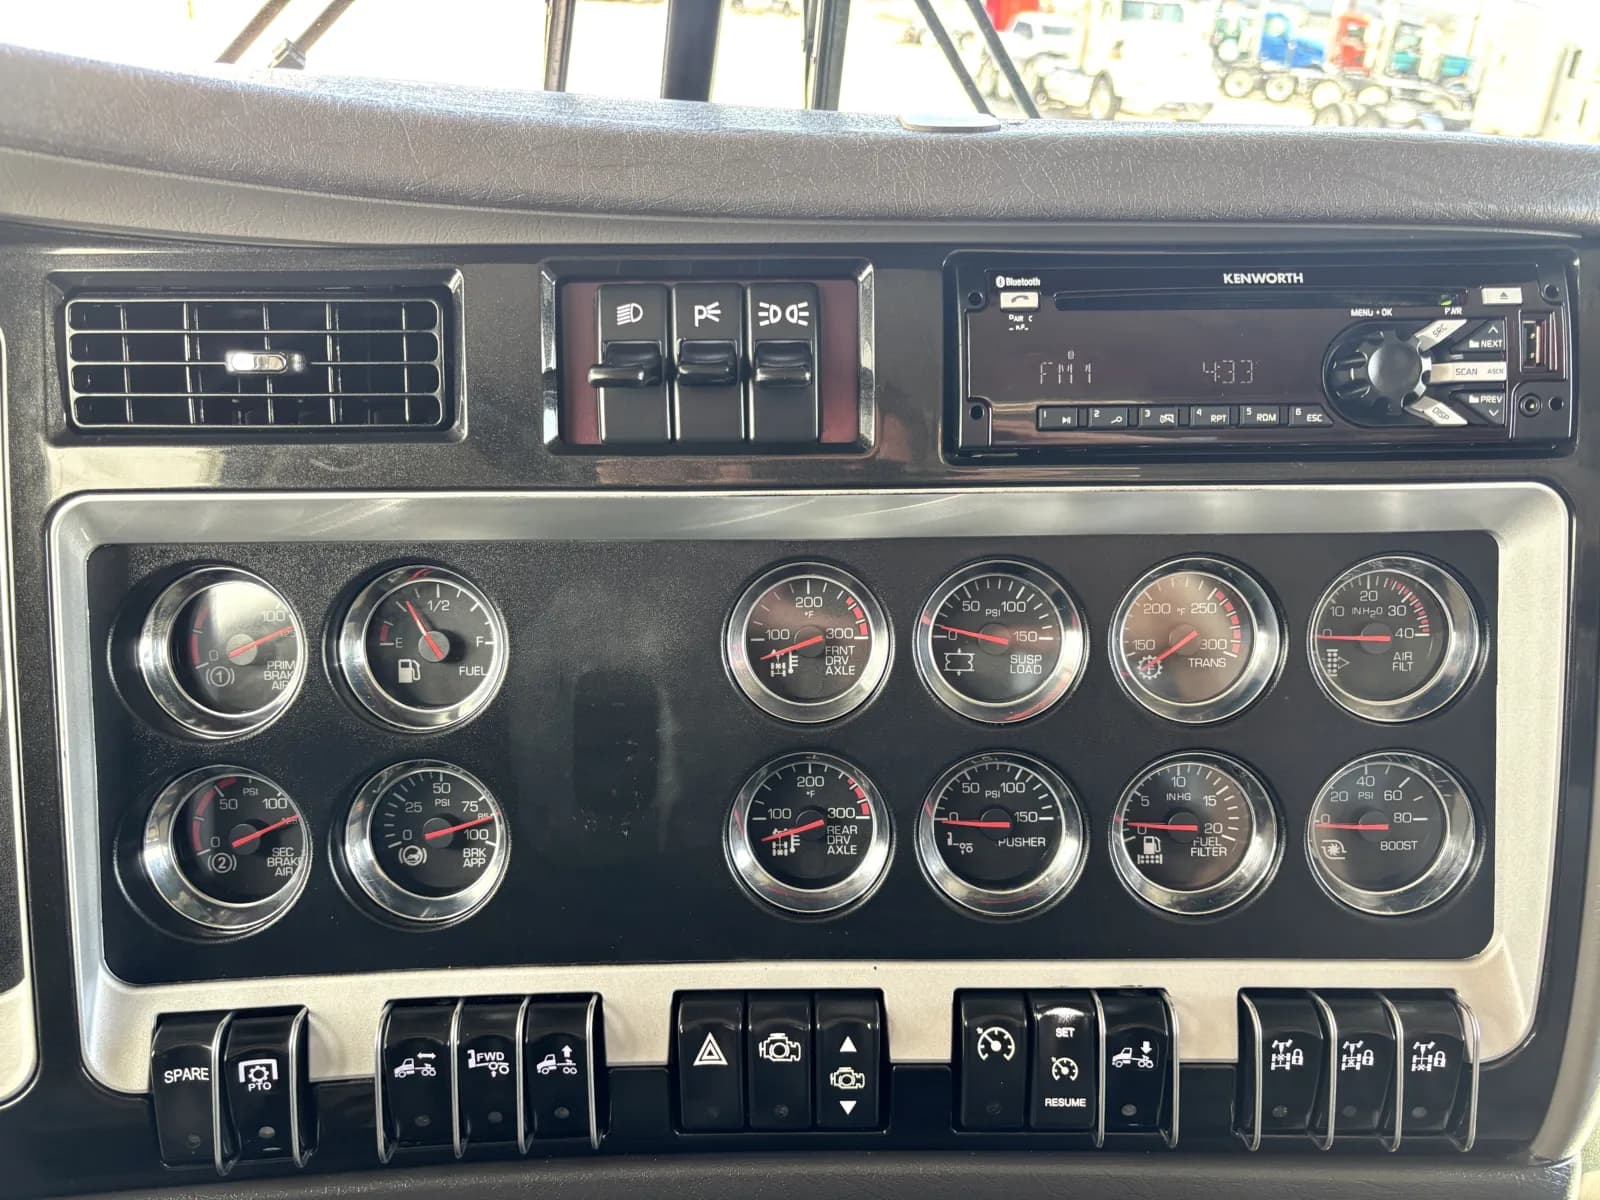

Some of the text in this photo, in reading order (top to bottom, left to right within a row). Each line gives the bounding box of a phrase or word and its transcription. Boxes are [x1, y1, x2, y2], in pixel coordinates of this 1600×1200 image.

[1005, 276, 1040, 287] Bluetooth
[1223, 272, 1304, 284] KENWORTH
[1350, 308, 1393, 317] MENU OK
[1432, 323, 1449, 338] SRC
[1481, 340, 1503, 348] NEXT
[1455, 368, 1478, 376] SCAN
[1480, 395, 1503, 404] PREV
[1093, 409, 1100, 418] 2
[1144, 409, 1151, 418] 3
[1196, 408, 1227, 423] 4 RPT
[1246, 407, 1252, 416] 5
[1295, 408, 1323, 422] 6 ESC
[1432, 406, 1450, 420] DISP
[1359, 590, 1378, 601] 20
[427, 600, 450, 612] 1/2
[795, 597, 823, 608] 200
[962, 601, 980, 612] 50
[1000, 601, 1026, 613] 100
[985, 609, 1000, 617] PSI
[1143, 603, 1170, 614] 200
[1190, 603, 1217, 614] 250
[1330, 606, 1345, 617] 10
[1388, 605, 1406, 616] 30
[263, 610, 286, 622] 100
[766, 629, 790, 640] 100
[825, 628, 853, 640] 300
[1014, 631, 1037, 642] 150
[1395, 628, 1414, 639] 40
[395, 638, 403, 648] E
[476, 636, 484, 647] F
[1133, 640, 1155, 650] 150
[1200, 639, 1227, 650] 300
[825, 646, 855, 655] FRNT
[1393, 652, 1413, 660] AIR
[267, 660, 296, 670] PRIM
[825, 656, 849, 665] DRV
[1010, 655, 1042, 664] SUSP
[1188, 658, 1226, 668] TRANS
[459, 666, 486, 676] FUEL
[825, 666, 855, 675] AXLE
[1010, 665, 1042, 675] LOAD
[1393, 662, 1414, 672] FILT
[264, 670, 295, 680] BRAK
[797, 776, 825, 787] 200
[1171, 777, 1186, 788] 10
[1356, 776, 1375, 787] 40
[243, 788, 258, 796] PSI
[433, 783, 451, 793] 50
[962, 782, 980, 793] 50
[1000, 782, 1026, 793] 100
[985, 790, 1000, 798] PSI
[1330, 791, 1348, 802] 20
[1358, 792, 1374, 800] PSI
[1384, 790, 1402, 801] 60
[219, 799, 238, 810] 50
[262, 798, 288, 809] 100
[434, 799, 450, 807] PSI
[461, 800, 479, 812] 75
[1140, 796, 1150, 807] 5
[1203, 796, 1217, 807] 15
[404, 802, 423, 813] 25
[768, 808, 792, 819] 100
[827, 808, 856, 819] 300
[1015, 812, 1038, 823] 150
[1321, 814, 1330, 824] 0
[1393, 812, 1412, 823] 80
[827, 825, 858, 835] REAR
[1204, 823, 1223, 834] 20
[402, 830, 412, 840] 0
[464, 829, 489, 840] 100
[827, 835, 850, 845] DRV
[210, 837, 220, 847] 0
[998, 837, 1046, 847] PUSHER
[1193, 837, 1222, 846] FUEL
[1380, 841, 1418, 851] BOOST
[271, 847, 294, 857] SEC
[463, 848, 487, 858] BRK
[827, 845, 857, 855] AXLE
[1191, 847, 1227, 857] FILTER
[463, 858, 486, 868] APP
[274, 867, 294, 877] AIR
[1056, 1027, 1075, 1037] SET
[476, 1051, 505, 1062] FWD
[164, 1067, 209, 1084] SPARE
[248, 1081, 272, 1092] PTO
[1044, 1098, 1087, 1107] RESUME
